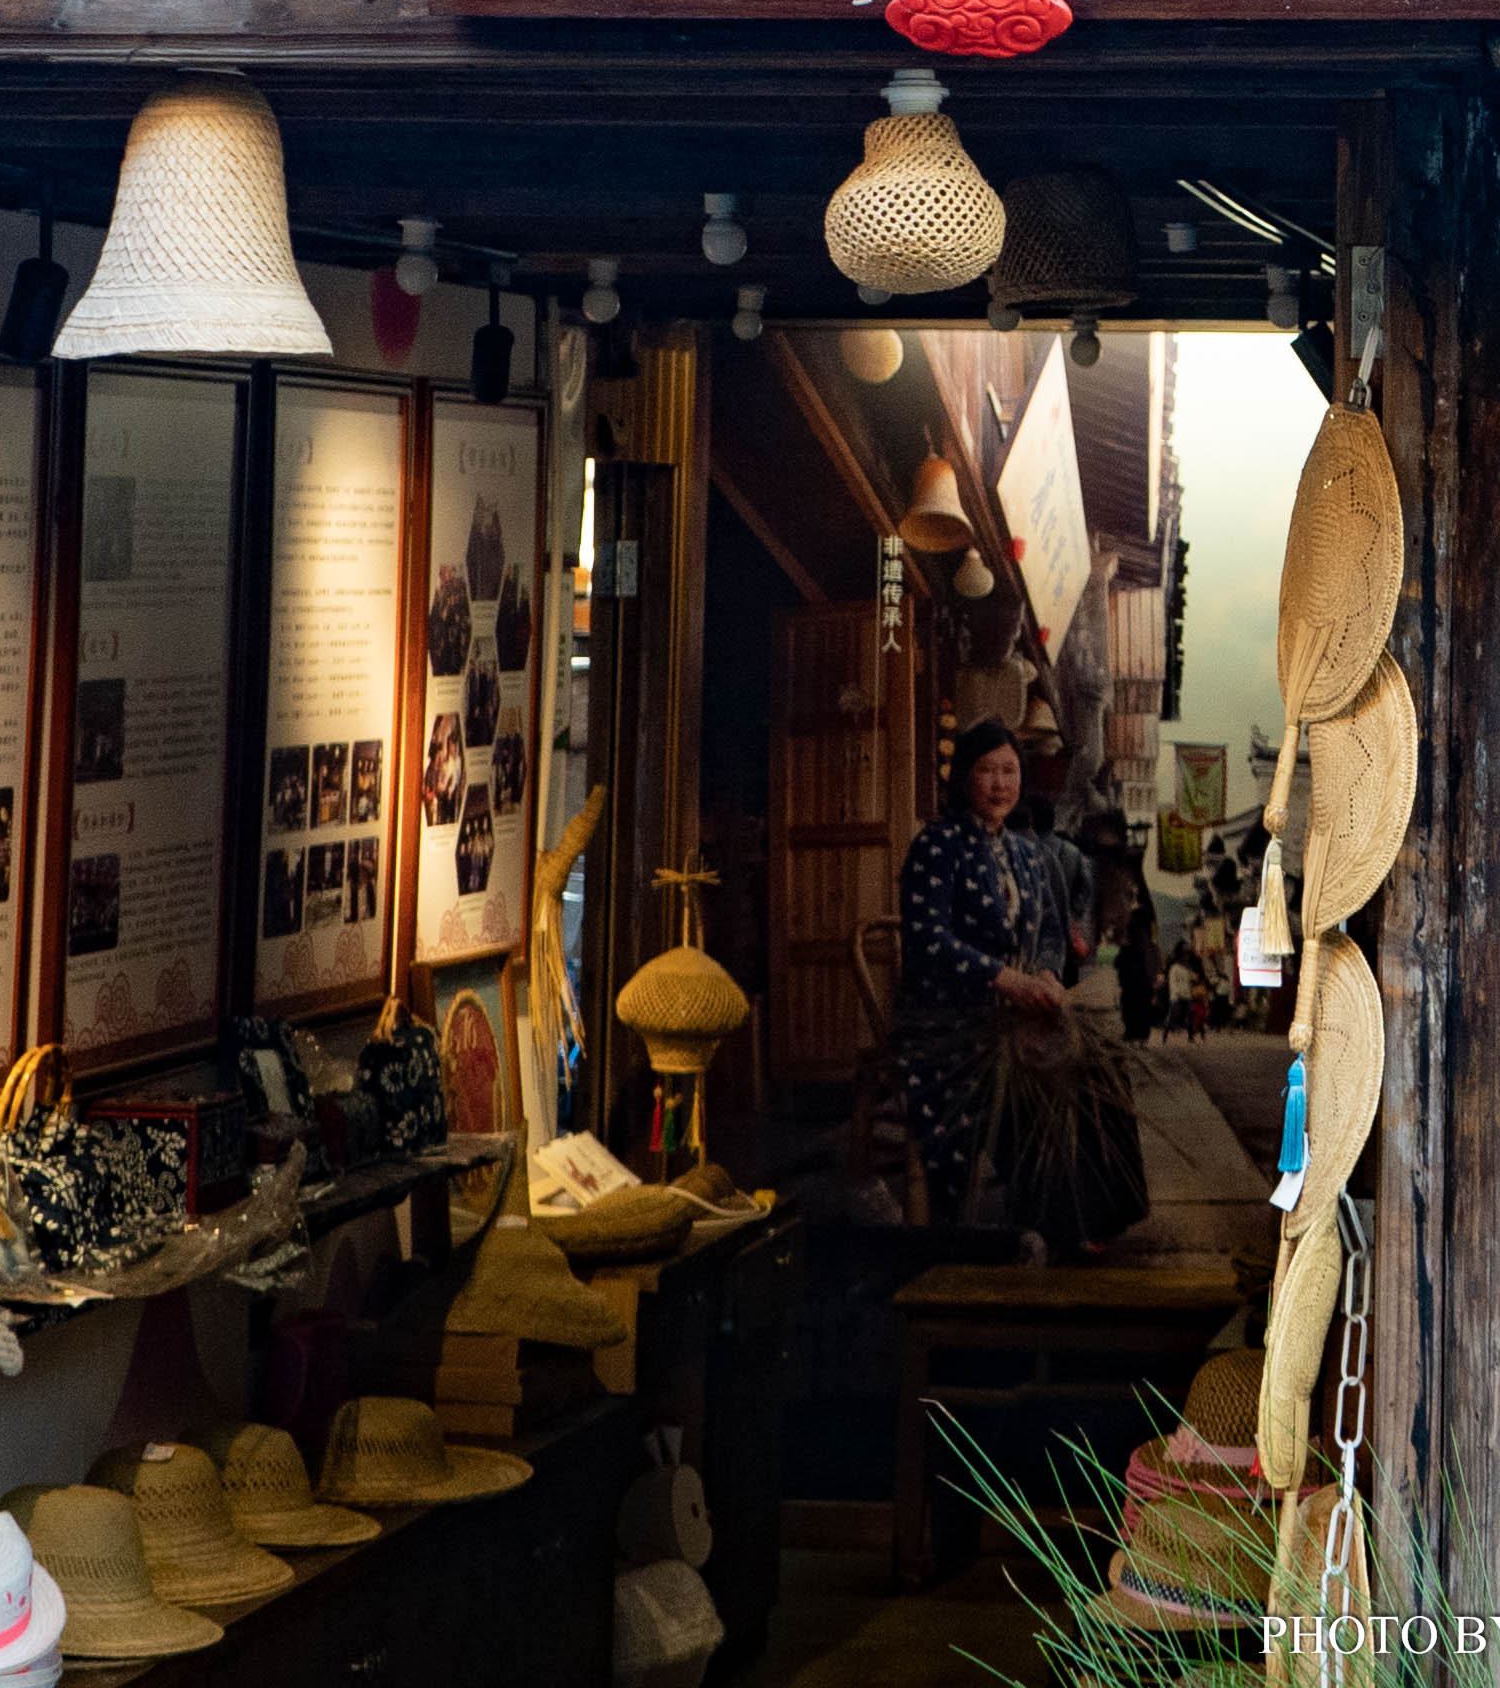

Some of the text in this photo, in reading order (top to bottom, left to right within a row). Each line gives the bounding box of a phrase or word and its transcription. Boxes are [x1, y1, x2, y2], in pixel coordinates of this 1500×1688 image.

[881, 535, 904, 653] 非遗传承人
